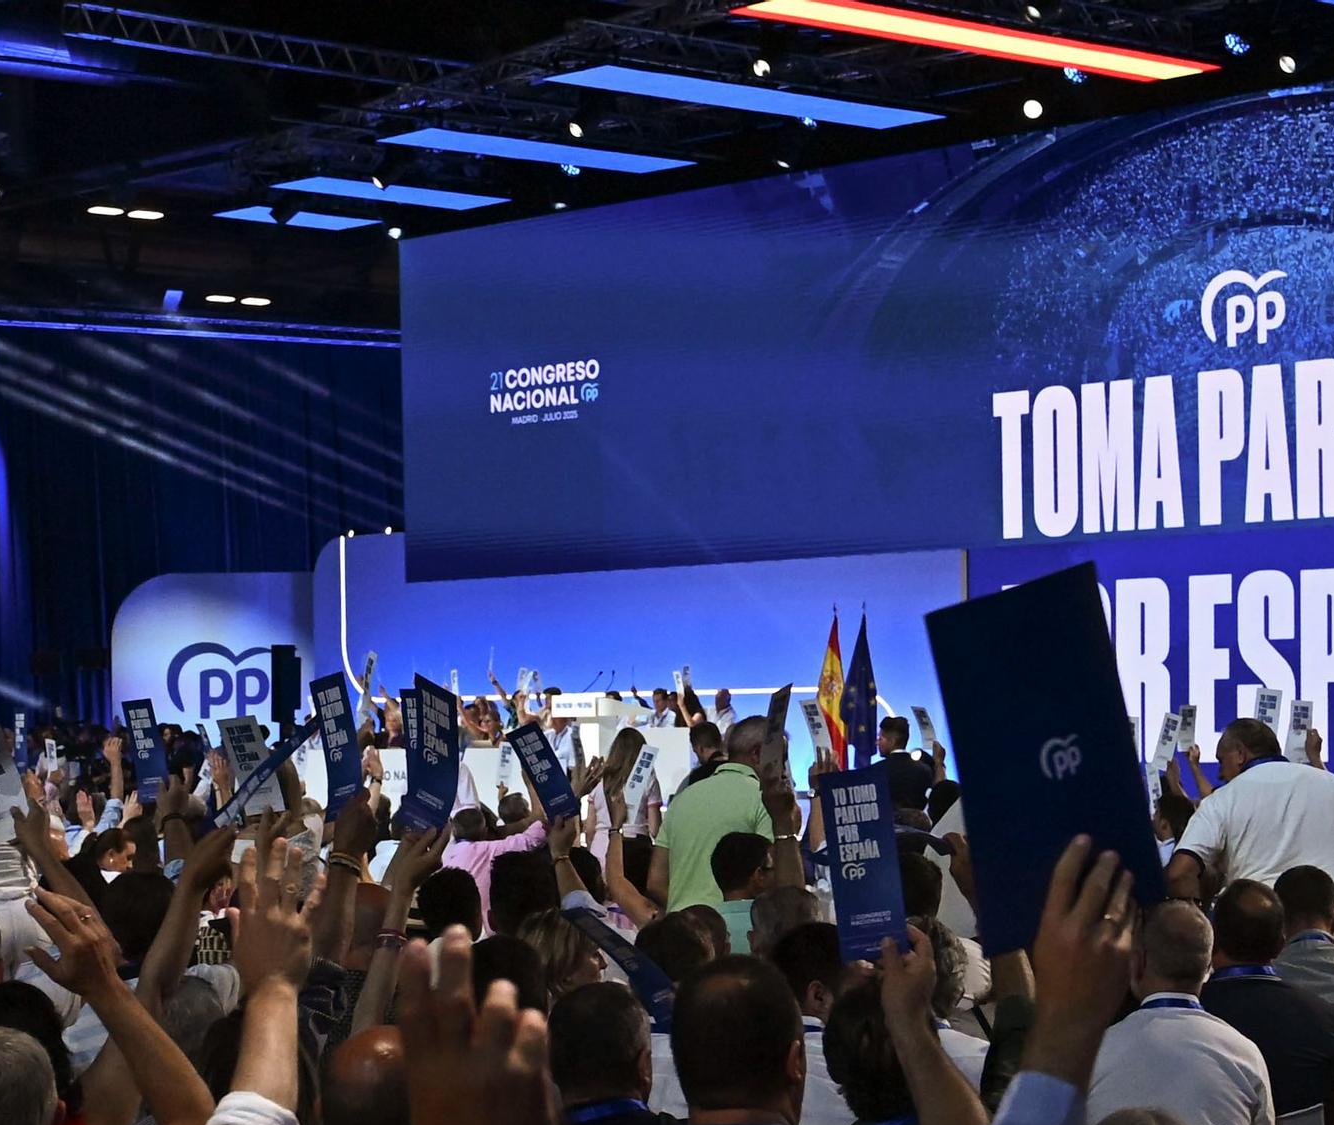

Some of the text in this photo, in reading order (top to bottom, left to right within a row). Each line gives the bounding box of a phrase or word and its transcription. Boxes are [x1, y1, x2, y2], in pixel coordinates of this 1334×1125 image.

[490, 359, 600, 391] 21 CONGRESO
[490, 385, 579, 414] NACIONAL
[992, 374, 1185, 540] TOMA
[832, 784, 877, 806] YO TOMO
[834, 802, 879, 825] PARTIDO
[837, 824, 859, 843] POR
[839, 838, 880, 862] ESPAÑA
